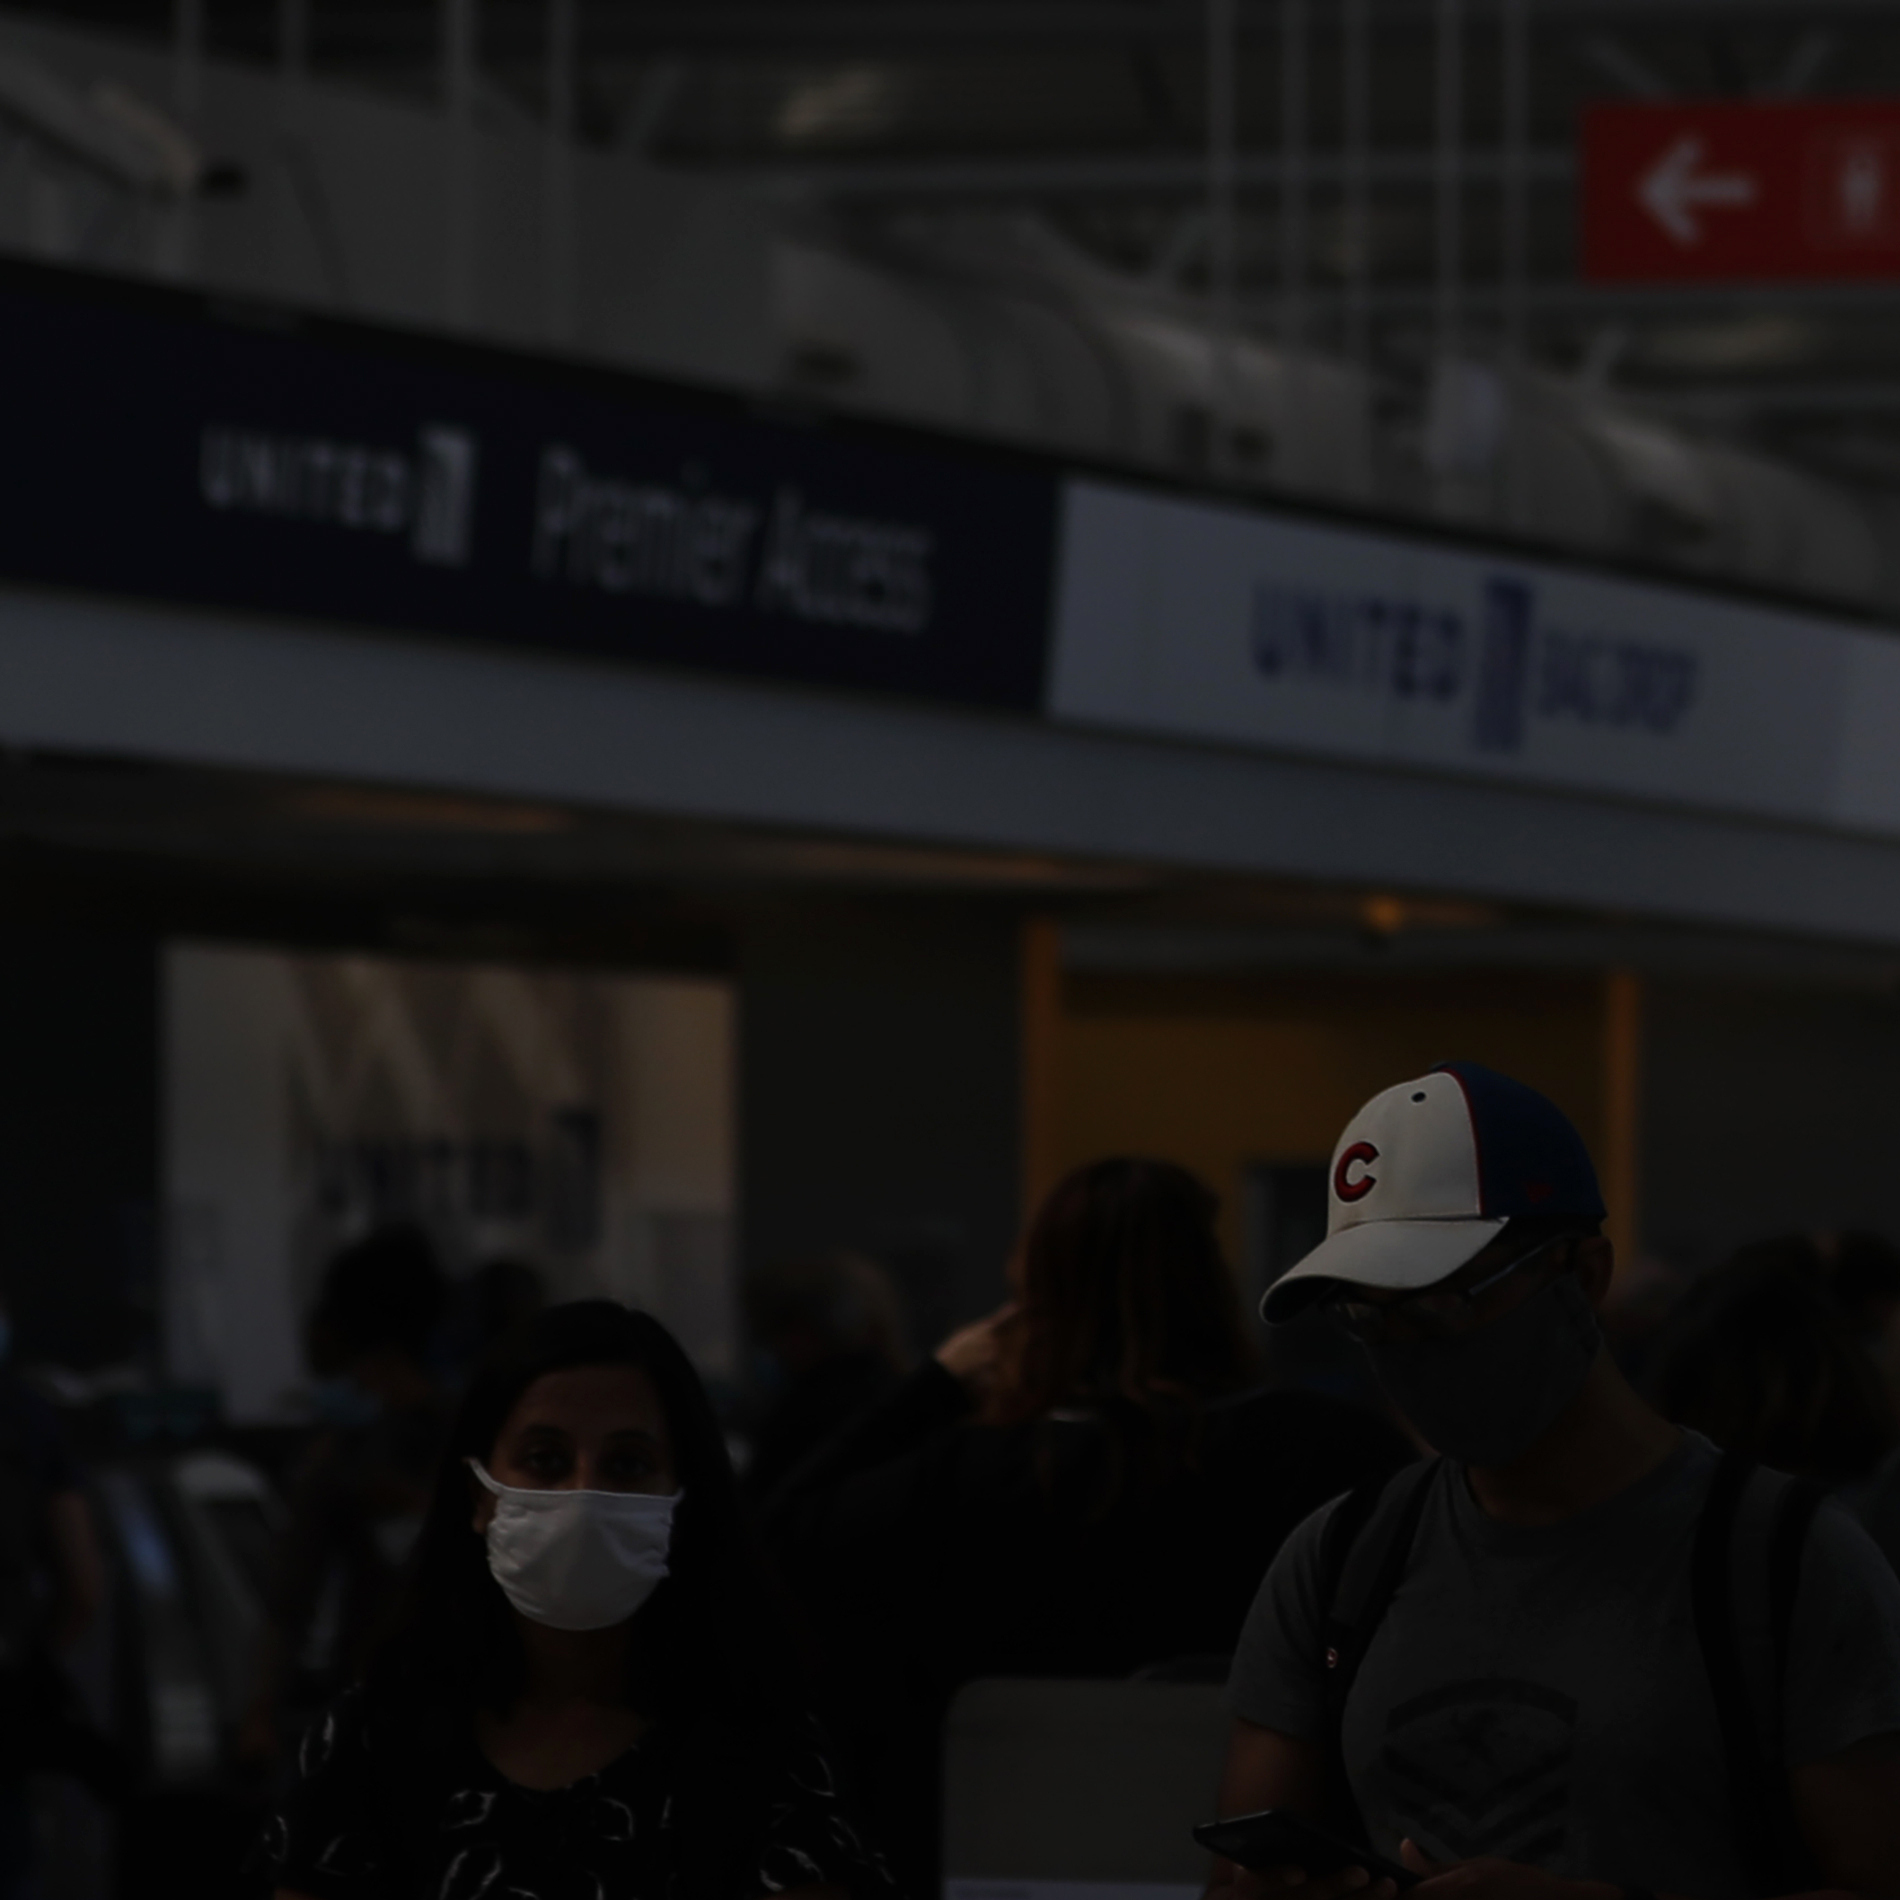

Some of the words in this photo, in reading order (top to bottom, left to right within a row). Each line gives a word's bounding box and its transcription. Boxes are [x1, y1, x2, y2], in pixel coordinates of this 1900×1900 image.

[199, 420, 417, 534] UNITED
[530, 442, 758, 608] Premier
[756, 482, 936, 636] Access
[1334, 1140, 1380, 1203] C
